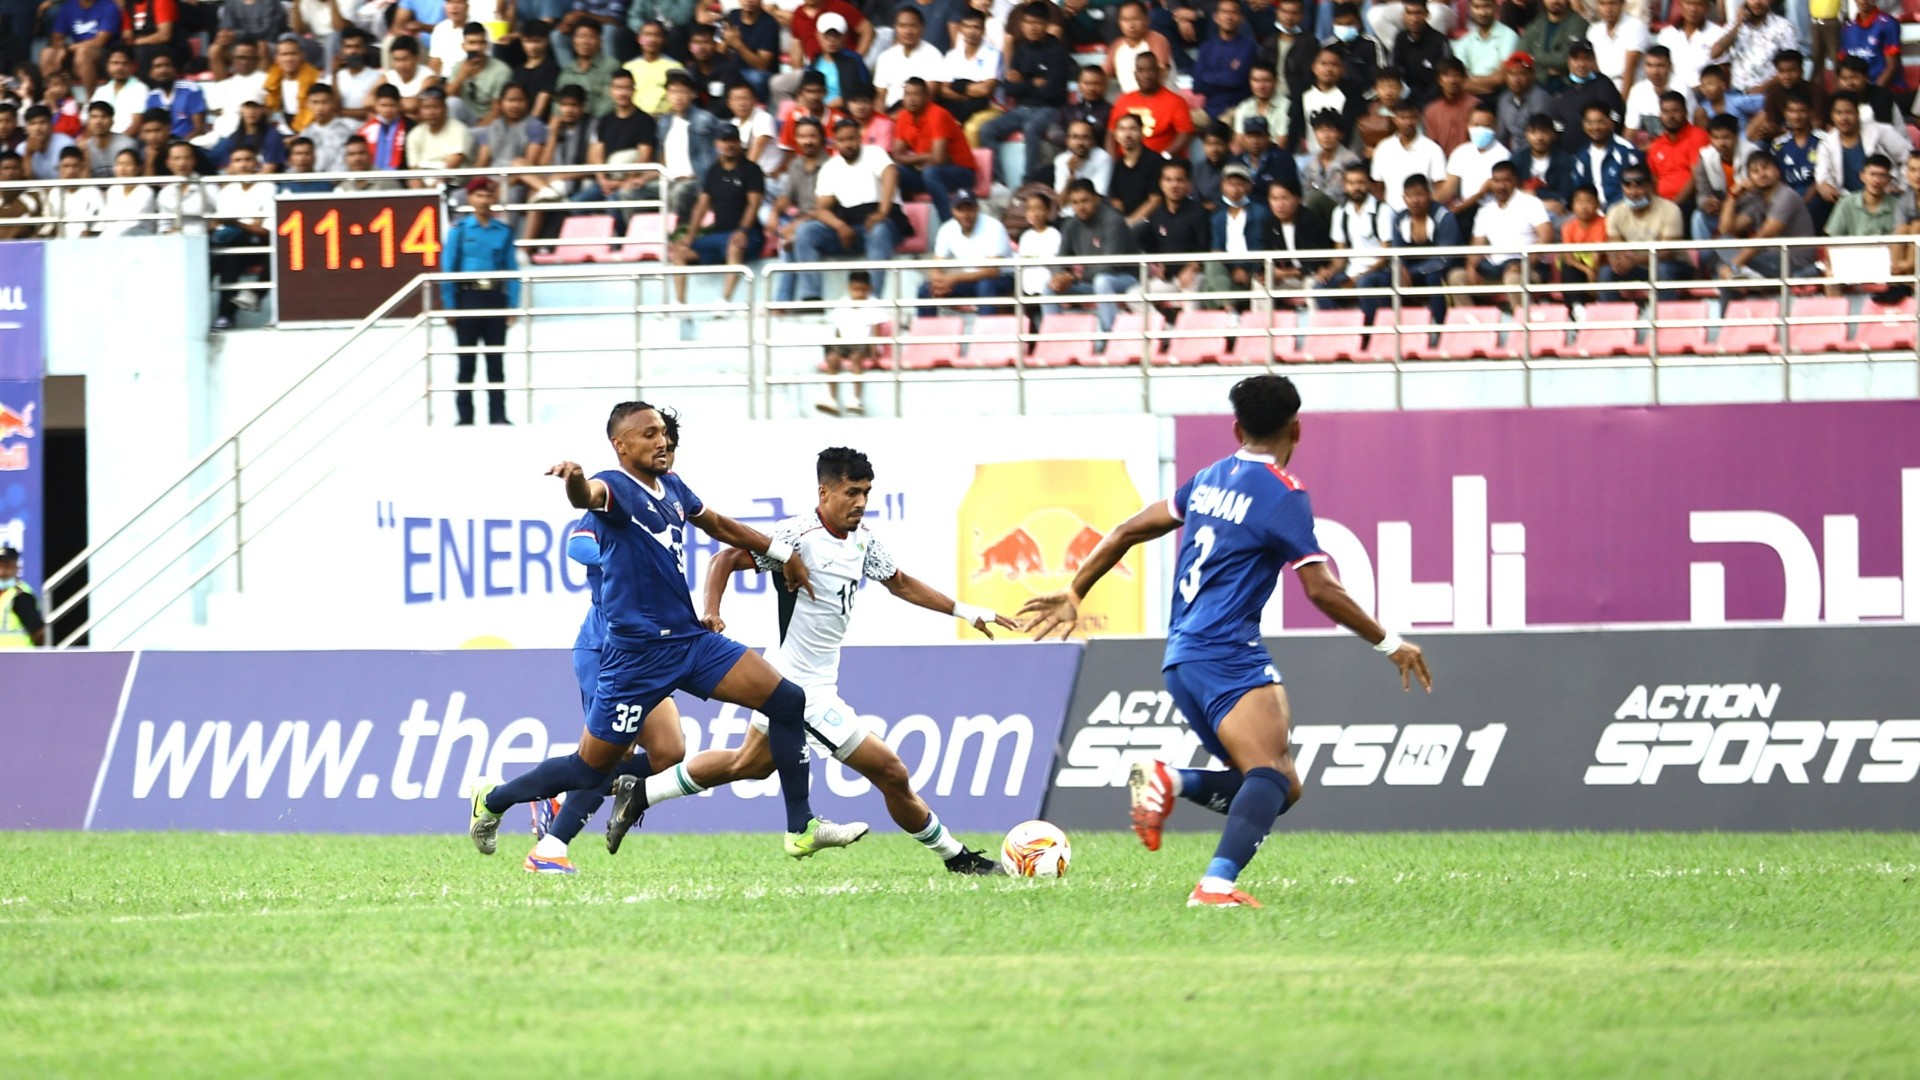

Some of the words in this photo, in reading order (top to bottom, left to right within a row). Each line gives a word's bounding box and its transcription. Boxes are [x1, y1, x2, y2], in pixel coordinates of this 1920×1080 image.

[278, 205, 442, 271] 11:14
[1179, 525, 1216, 604] 3
[612, 703, 643, 733] 32
[1614, 683, 1781, 720] ACTION
[1461, 722, 1508, 787] 1
[1583, 719, 1920, 785] SPORTS
